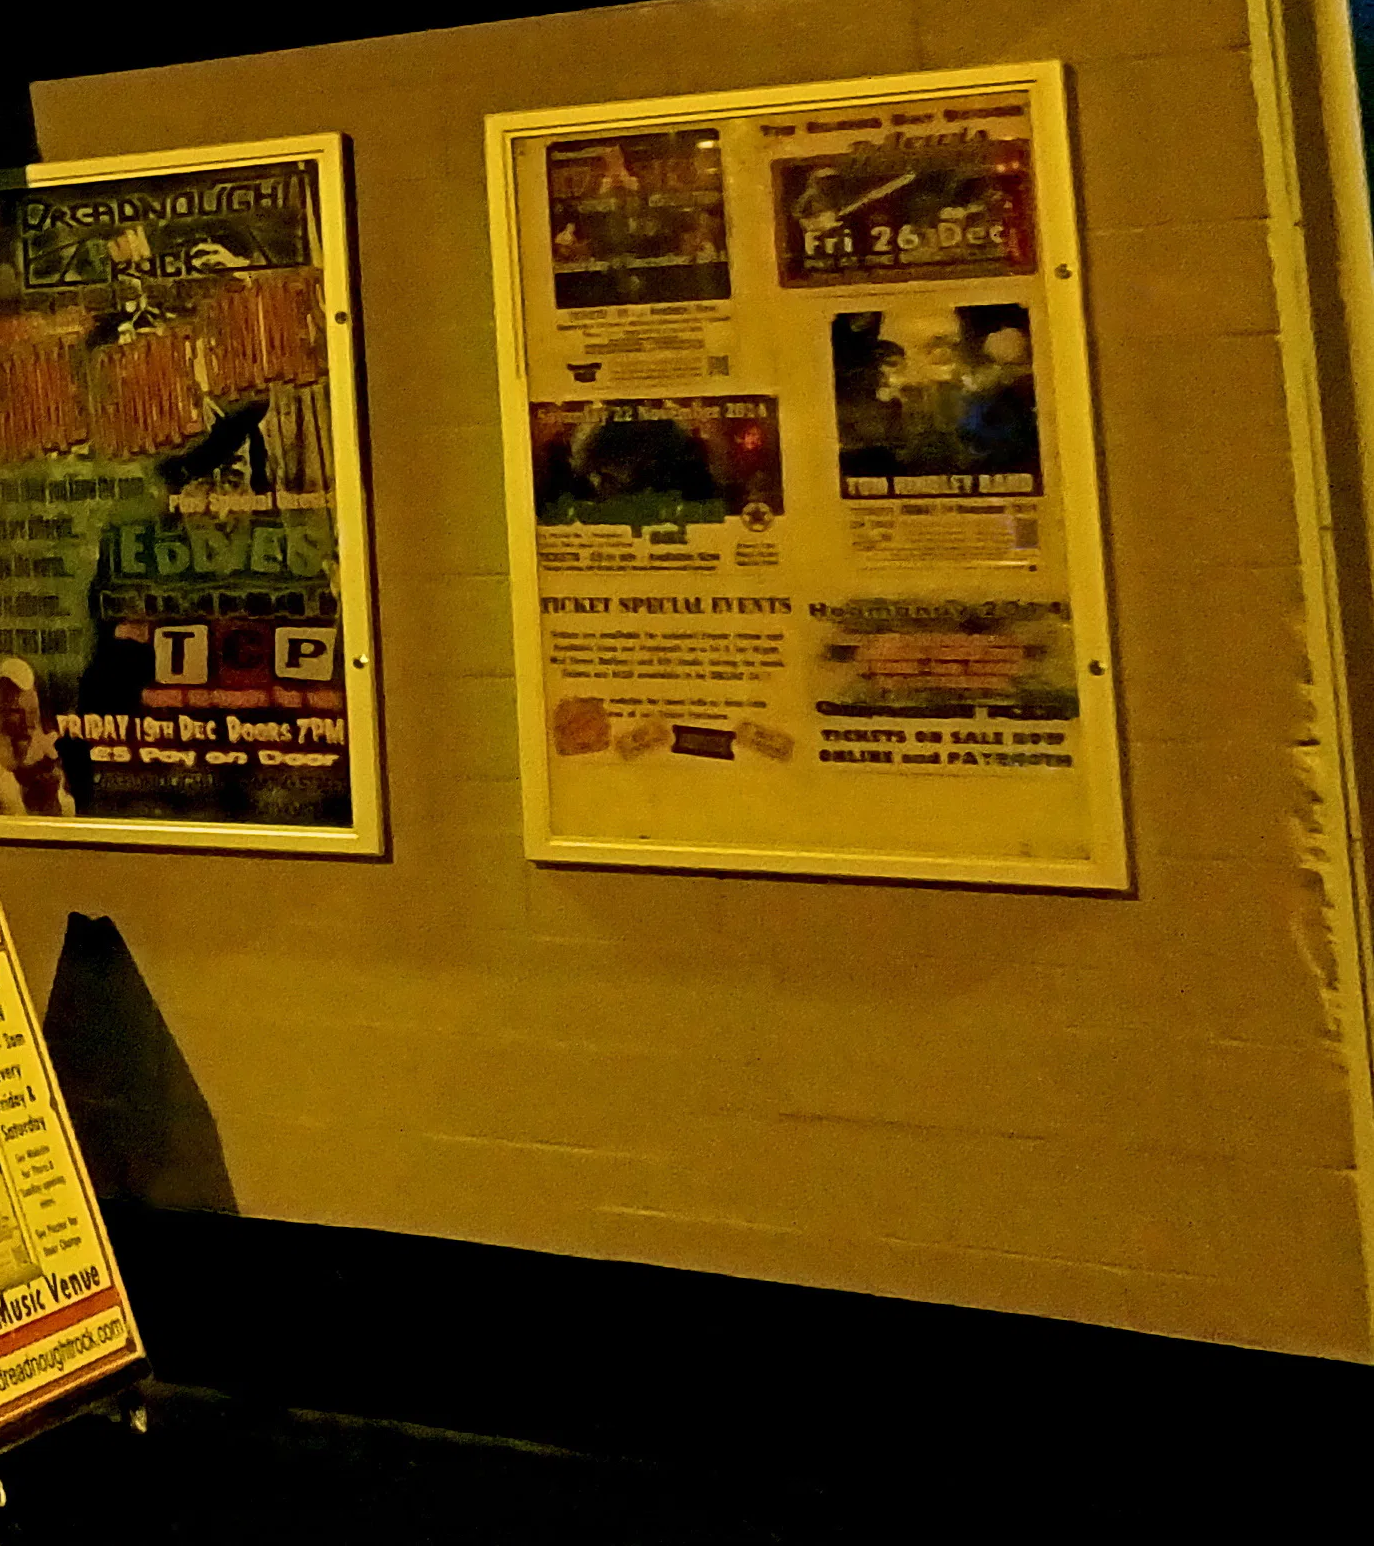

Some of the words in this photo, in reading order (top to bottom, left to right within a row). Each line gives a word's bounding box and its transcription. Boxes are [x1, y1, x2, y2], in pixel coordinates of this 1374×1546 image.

[803, 228, 853, 255] Fri
[870, 223, 920, 253] 26
[936, 222, 1005, 247] Dec
[541, 596, 612, 614] TICKET
[618, 596, 705, 614] SPECIAL
[711, 596, 793, 615] EVENTS
[56, 713, 129, 741] FRIDAY
[296, 718, 345, 746] 7PM
[950, 731, 1004, 745] SALE
[25, 1084, 37, 1103] &
[1, 1113, 48, 1142] Saturday
[42, 1265, 101, 1303] Venue
